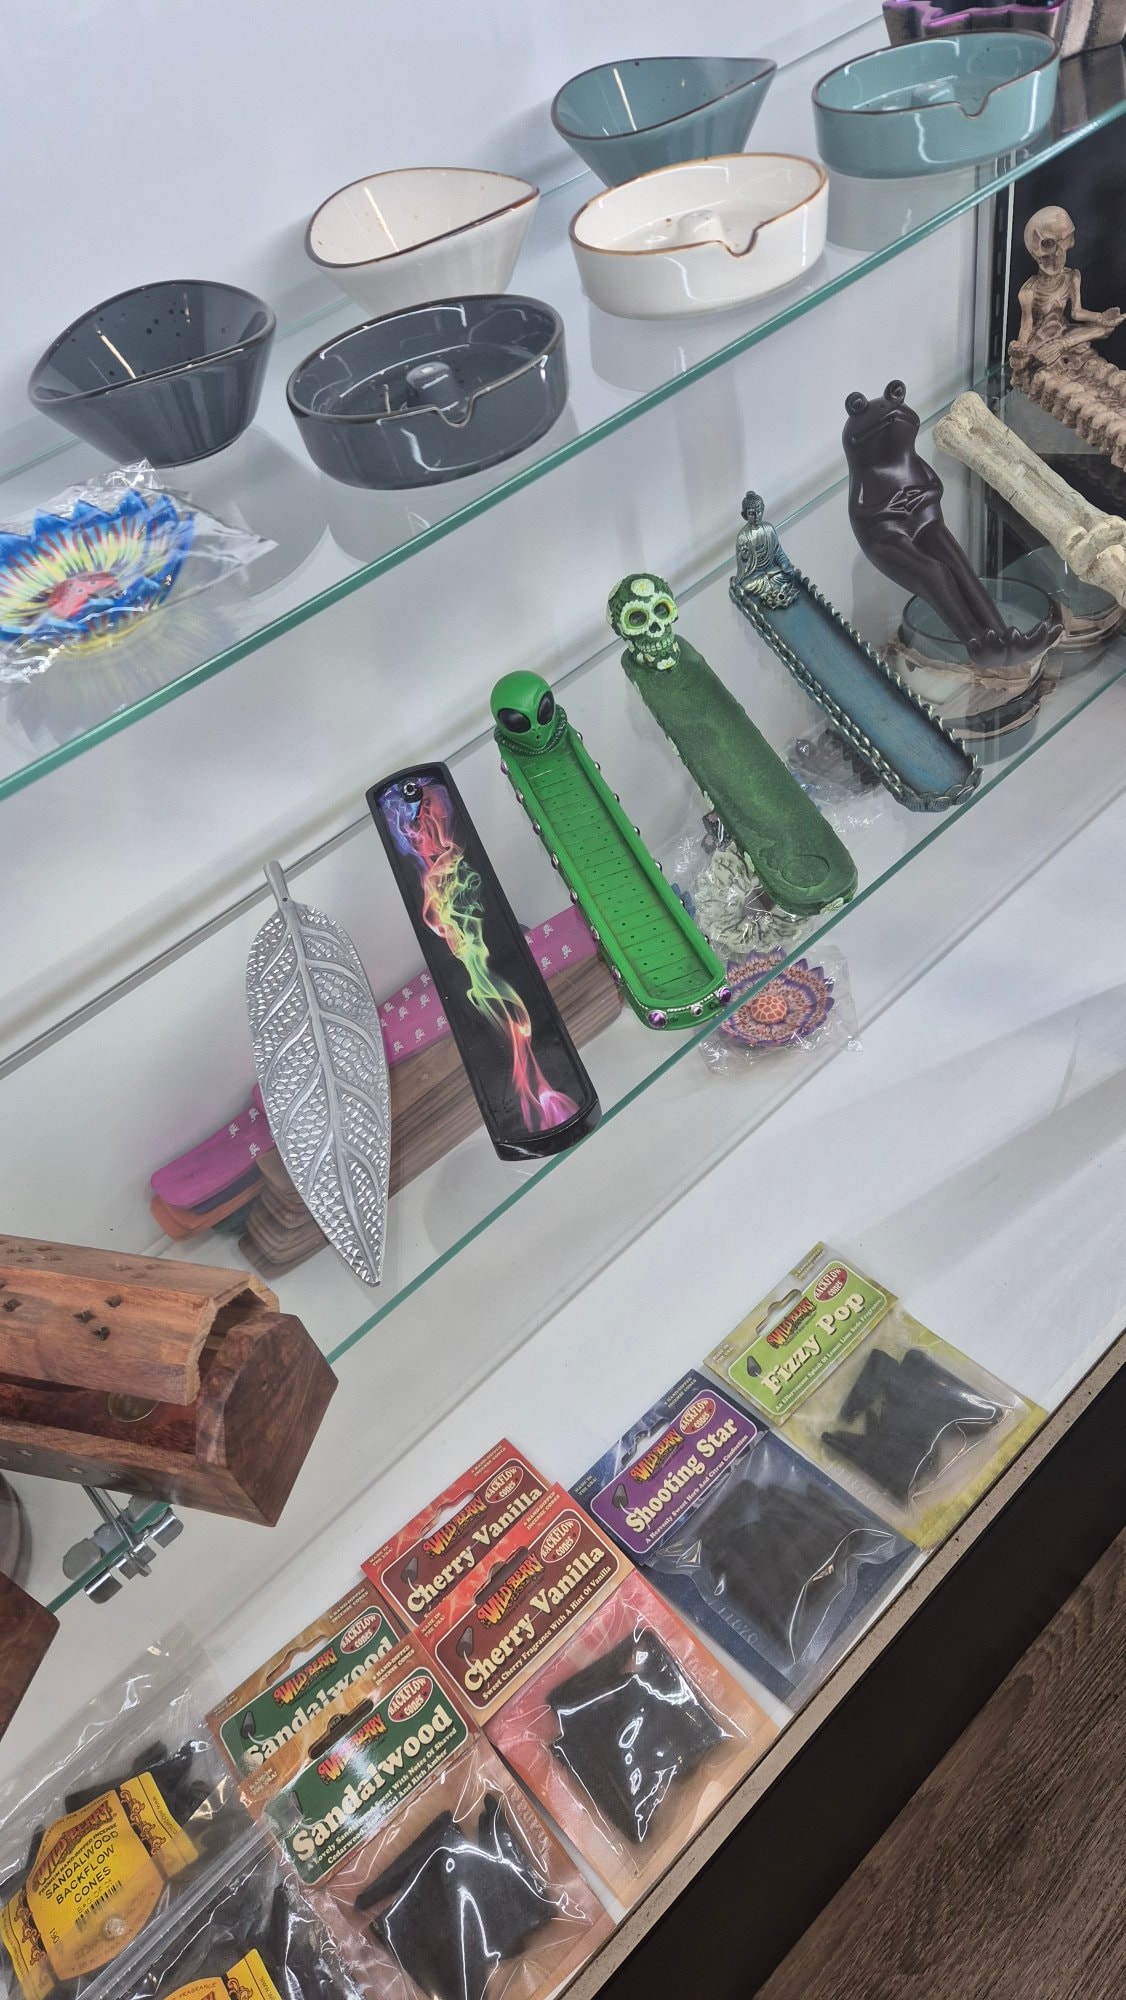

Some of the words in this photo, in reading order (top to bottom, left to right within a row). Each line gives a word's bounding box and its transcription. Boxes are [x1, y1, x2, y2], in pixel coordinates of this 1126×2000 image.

[815, 1268, 842, 1298] BACKFLOW
[761, 1334, 821, 1395] Fizzy
[816, 1293, 865, 1335] Pop
[767, 1319, 792, 1346] WILD
[808, 1362, 823, 1377] Splash
[827, 1342, 841, 1357] Lemon
[681, 1399, 709, 1430] BACKFLOW
[626, 1454, 705, 1532] Shooting
[696, 1418, 738, 1457] Star
[630, 1453, 658, 1481] WILD
[653, 1428, 684, 1455] BERRY
[486, 1467, 518, 1499] BACKFLOW
[649, 1515, 673, 1538] Heavenly
[672, 1500, 688, 1517] Sweet
[686, 1487, 700, 1502] Herb
[698, 1476, 710, 1489] And
[708, 1461, 725, 1478] Citrus
[723, 1434, 748, 1462] Confection
[407, 1545, 475, 1612] Cherry
[472, 1488, 543, 1545] Vanilla
[423, 1523, 457, 1555] WILD
[453, 1494, 488, 1526] BERRY
[542, 1520, 575, 1558] BACKFLOW
[478, 1586, 513, 1624] WILD
[507, 1553, 545, 1589] BERRY
[341, 1615, 377, 1649] BACKFLOW
[464, 1613, 535, 1691] Cherry
[529, 1547, 605, 1614] Vanilla
[482, 1679, 503, 1700] Sweet
[501, 1658, 524, 1681] Cherry
[521, 1629, 552, 1660] Fragrance
[549, 1613, 567, 1631] With
[566, 1609, 573, 1617] A
[570, 1593, 585, 1610] Hint
[583, 1584, 592, 1595] Of
[590, 1565, 612, 1588] Vanilla
[273, 1672, 308, 1707] WILD
[303, 1647, 339, 1683] BERRY
[376, 1644, 411, 1678] HAND-DIPPED
[376, 1665, 400, 1686] INCENSE
[398, 1648, 415, 1667] CONES
[388, 1676, 428, 1716] BACKFLOW
[350, 1712, 387, 1747] BERRY
[292, 1704, 453, 1861] Sandalwood
[314, 1843, 336, 1865] Lovely
[392, 1773, 409, 1791] With
[407, 1758, 427, 1775] Notes
[425, 1748, 435, 1760] Of
[434, 1726, 457, 1751] Shaved
[399, 1783, 413, 1799] And
[411, 1769, 428, 1786] Rich
[427, 1749, 448, 1771] Amber
[38, 1871, 61, 1896] PREMIUM
[60, 1838, 94, 1873] HAND-DIPPED
[92, 1822, 118, 1839] INCENSE
[45, 1830, 119, 1899] SANDALWOOD
[56, 1844, 115, 1905] BACKFLOW
[74, 1866, 111, 1903] CONES
[179, 1981, 217, 1998] FRAGRANCE
